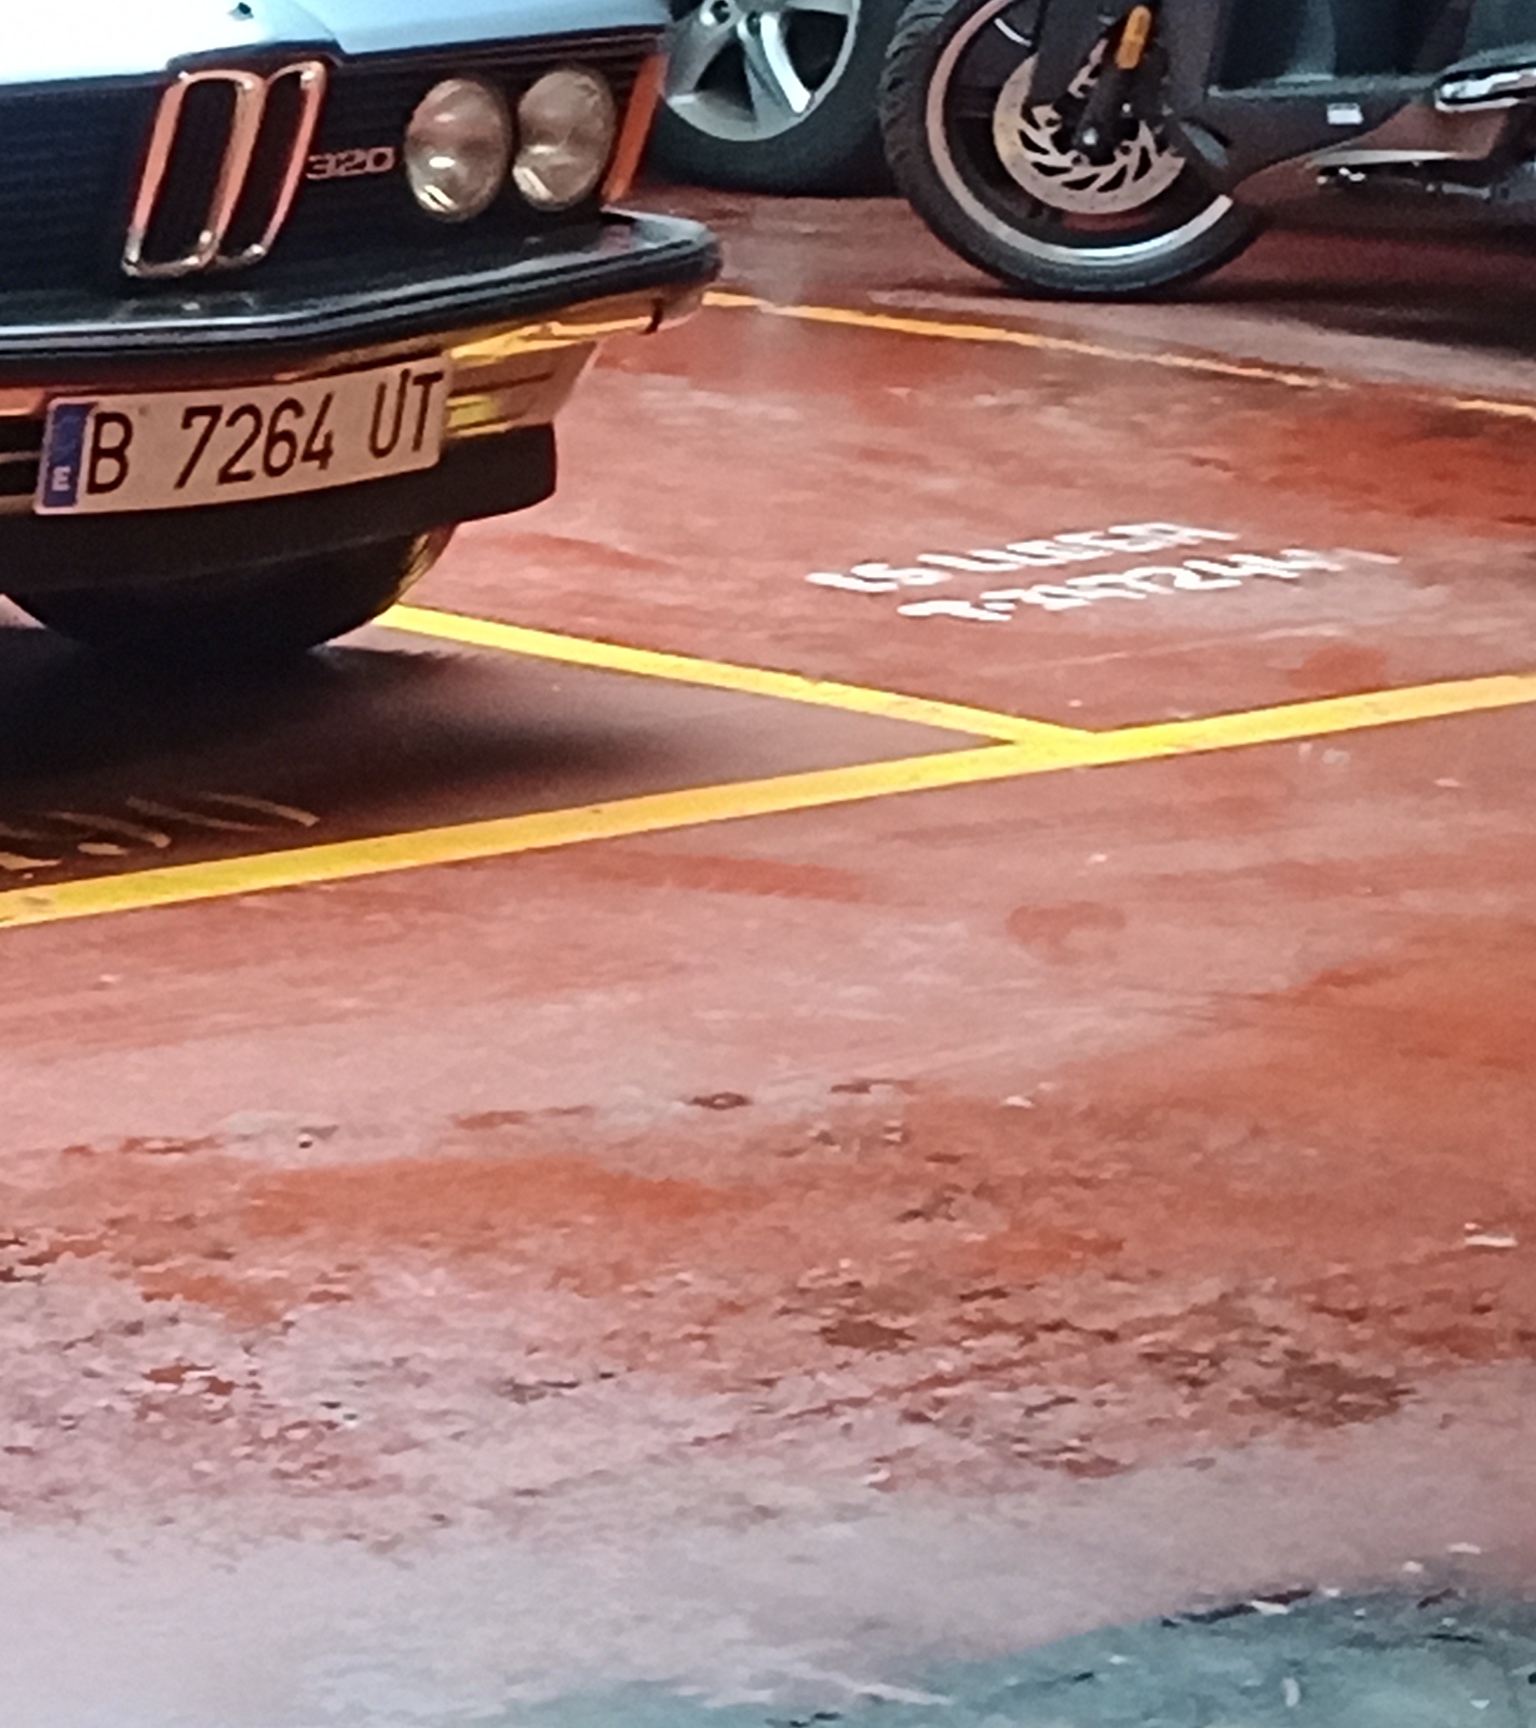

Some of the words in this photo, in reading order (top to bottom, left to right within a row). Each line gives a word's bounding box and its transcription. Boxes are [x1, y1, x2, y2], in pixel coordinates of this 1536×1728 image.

[306, 146, 395, 180] 320
[86, 411, 133, 495] B
[173, 392, 334, 490] 7264
[368, 368, 444, 459] UT
[51, 466, 71, 491] E
